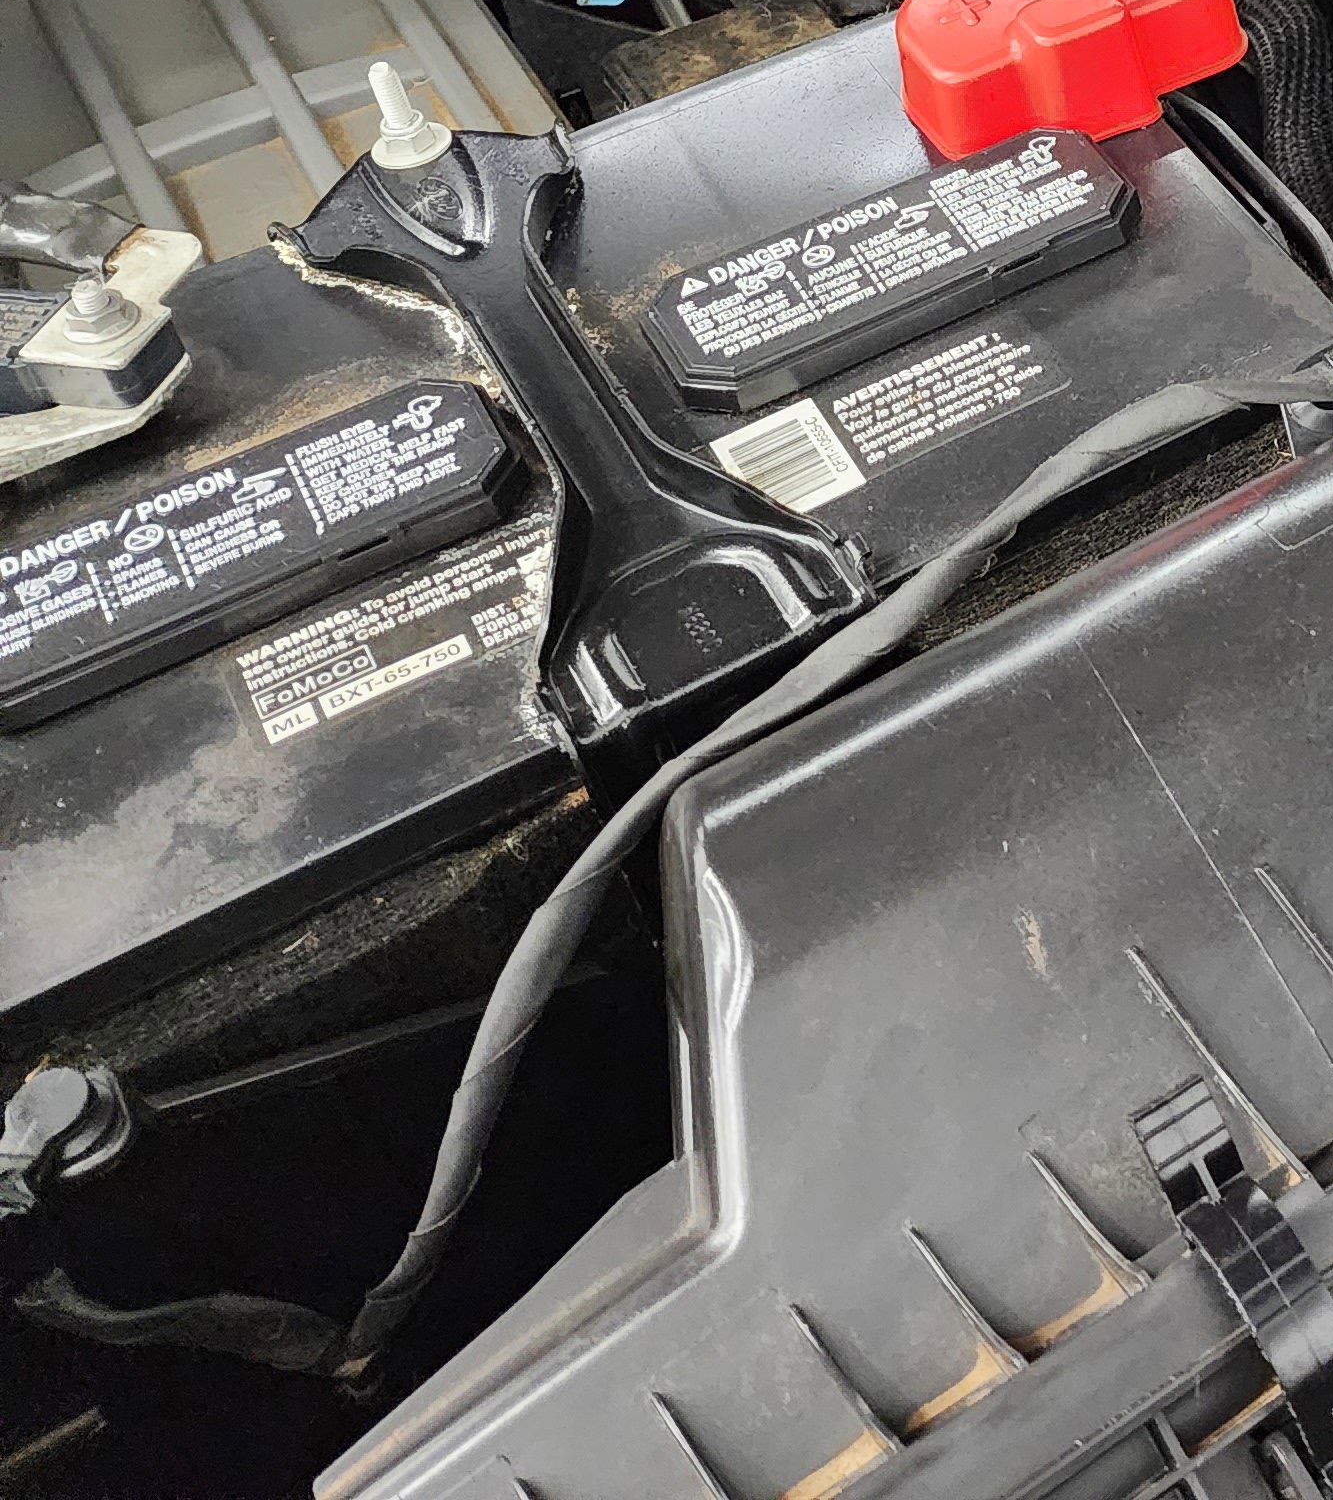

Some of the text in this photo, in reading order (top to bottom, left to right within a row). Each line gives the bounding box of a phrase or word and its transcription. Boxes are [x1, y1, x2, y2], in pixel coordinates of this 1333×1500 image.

[806, 256, 859, 286] AUCUNE
[830, 334, 989, 414] AVERTISSEMENT
[931, 378, 952, 394] du
[996, 362, 1016, 377] de
[837, 400, 878, 424] Pour
[914, 370, 944, 388] des
[294, 433, 340, 460] FLUSH
[299, 424, 390, 470] IMMEDIATELY
[304, 456, 342, 479] WITH
[310, 417, 466, 489] GET MEDICAL HELP FAST
[865, 449, 886, 464] de
[318, 492, 338, 506] OF
[322, 500, 342, 514] DO
[342, 488, 370, 506] NOT
[424, 452, 457, 472] VENT
[397, 475, 424, 494] AND
[177, 486, 292, 542] SULFURIC ACID
[184, 516, 256, 554] CAN CAUSE
[106, 551, 134, 572] NO
[188, 519, 282, 564] BLINDNESS OR
[193, 530, 286, 576] SEVERE BURNS
[40, 583, 93, 614] GASES
[360, 597, 384, 614] To
[385, 576, 432, 604] avoid
[432, 544, 504, 585] personal
[276, 634, 330, 664] owner
[380, 600, 406, 618] for
[452, 563, 493, 587] start
[354, 616, 396, 642] Cold
[396, 586, 472, 624] cranking
[476, 611, 520, 638] FORD
[258, 652, 372, 712] FoMoCo
[270, 641, 462, 735] ML BXT-65-750
